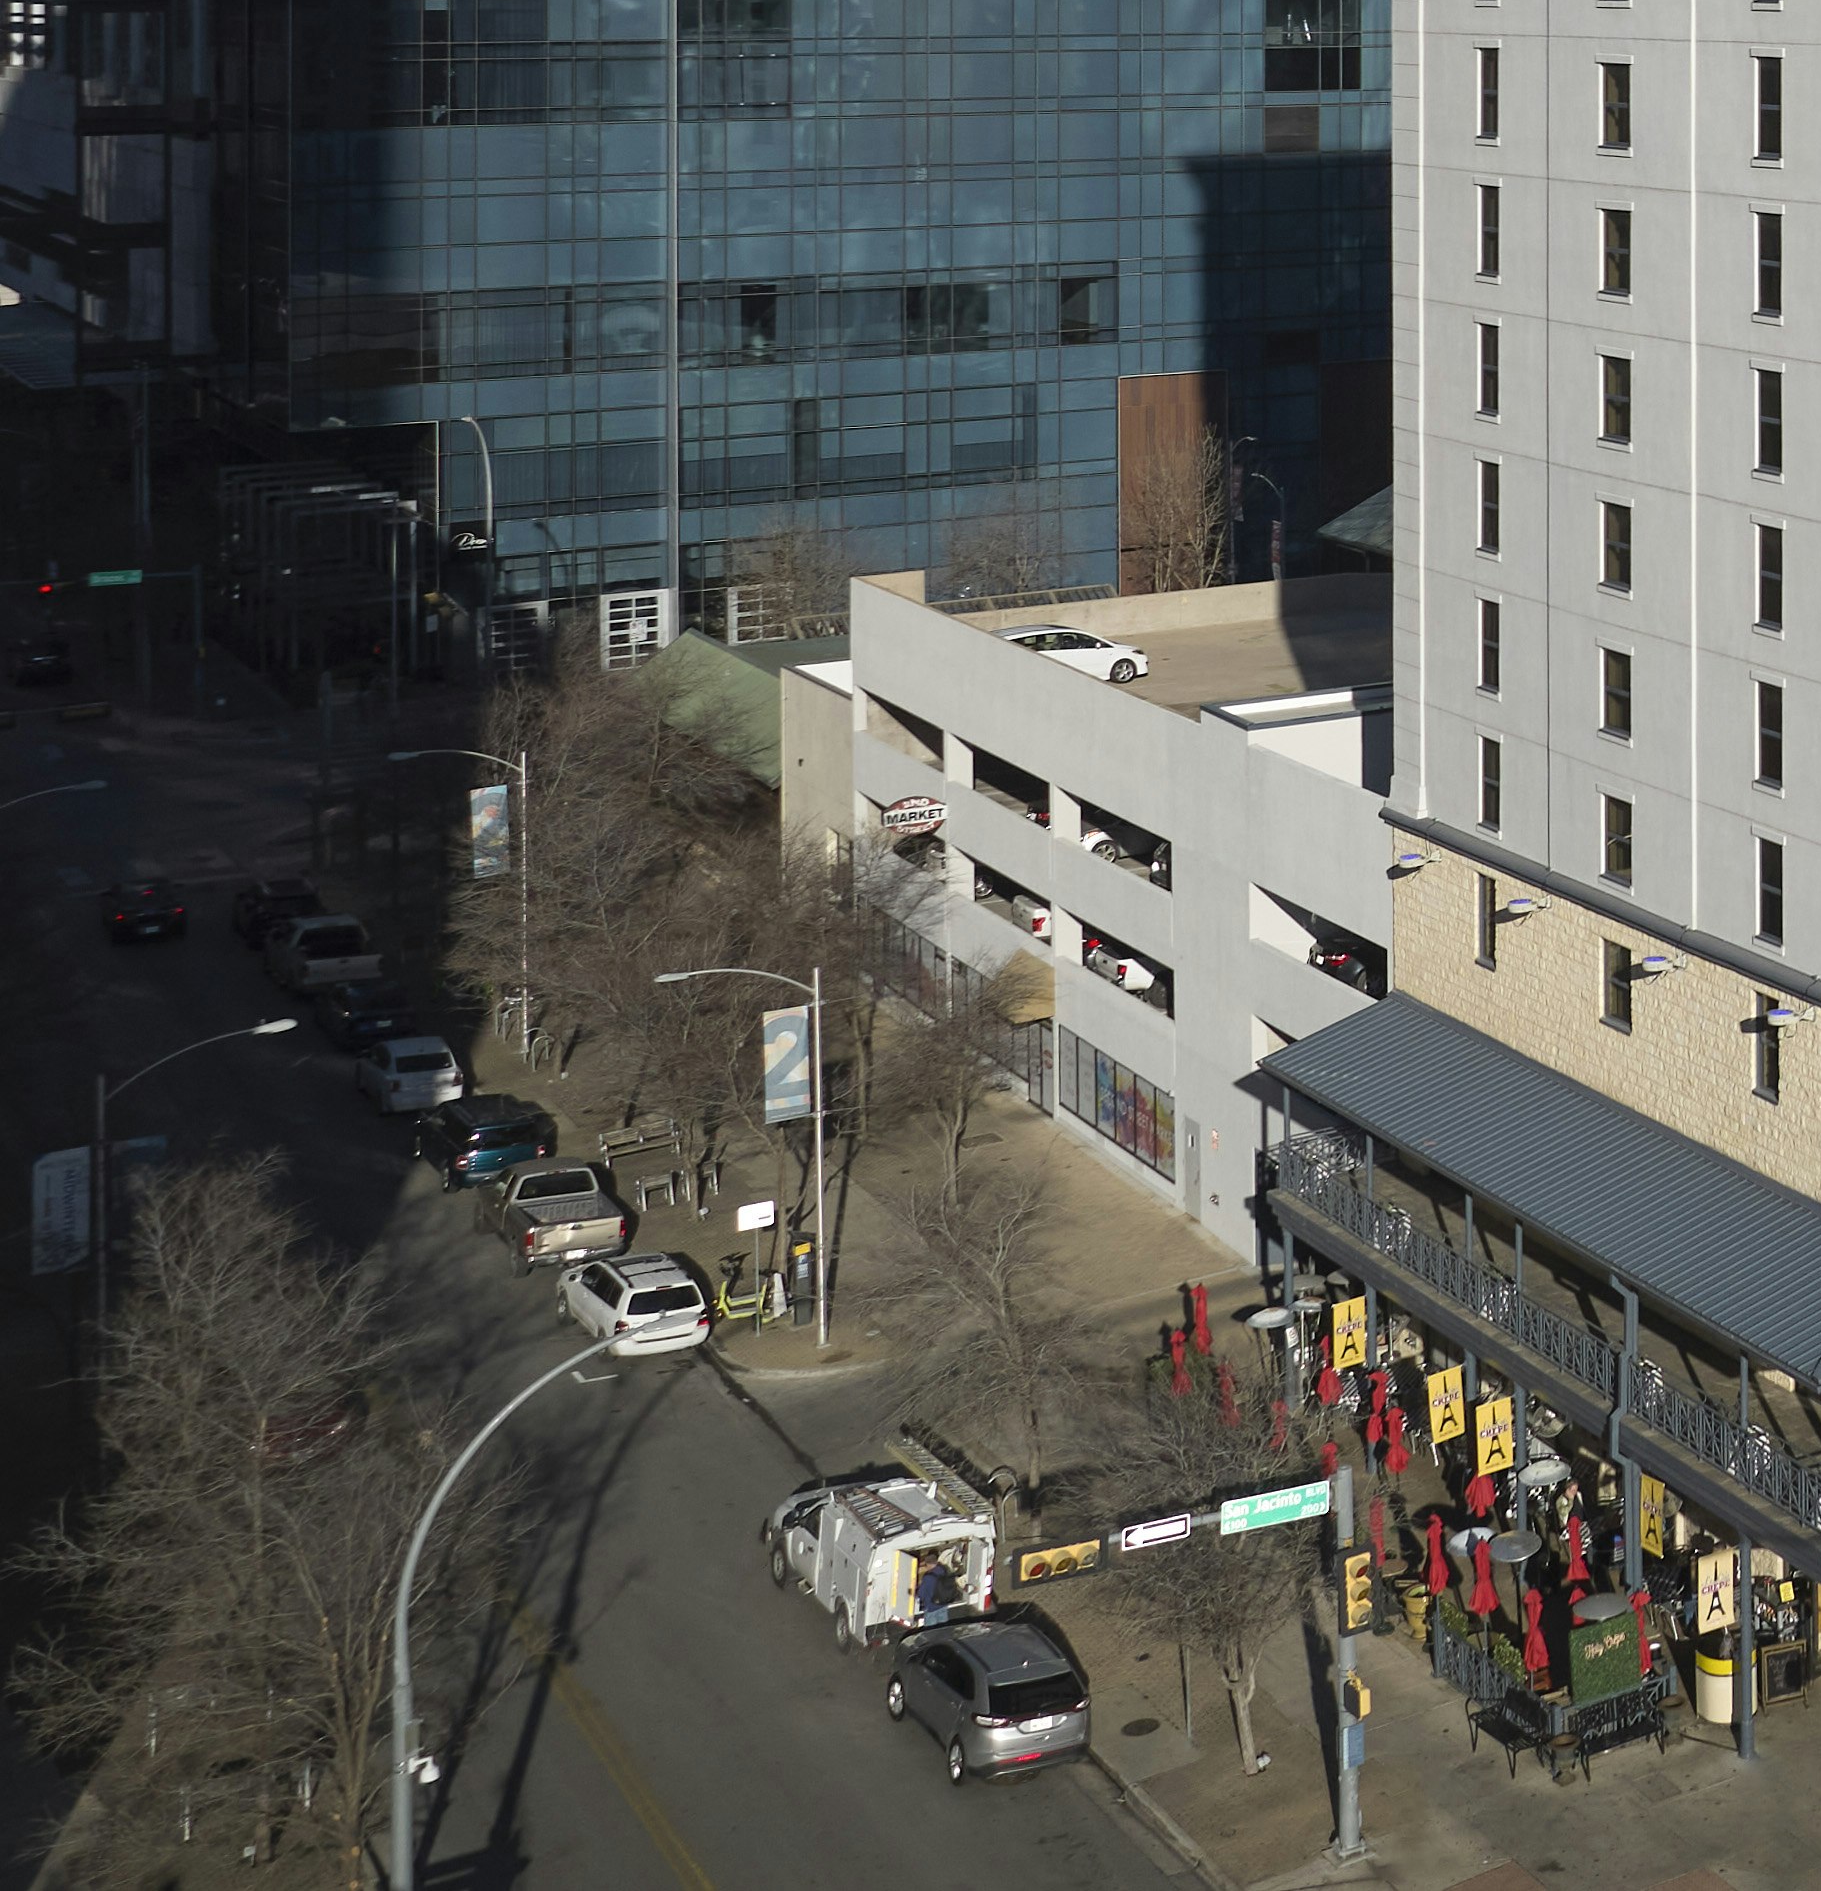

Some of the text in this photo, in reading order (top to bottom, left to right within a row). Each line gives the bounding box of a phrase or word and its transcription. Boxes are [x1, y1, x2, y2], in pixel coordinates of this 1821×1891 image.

[886, 808, 944, 824] MARKET
[1224, 1484, 1326, 1519] San Jacinto BLVD
